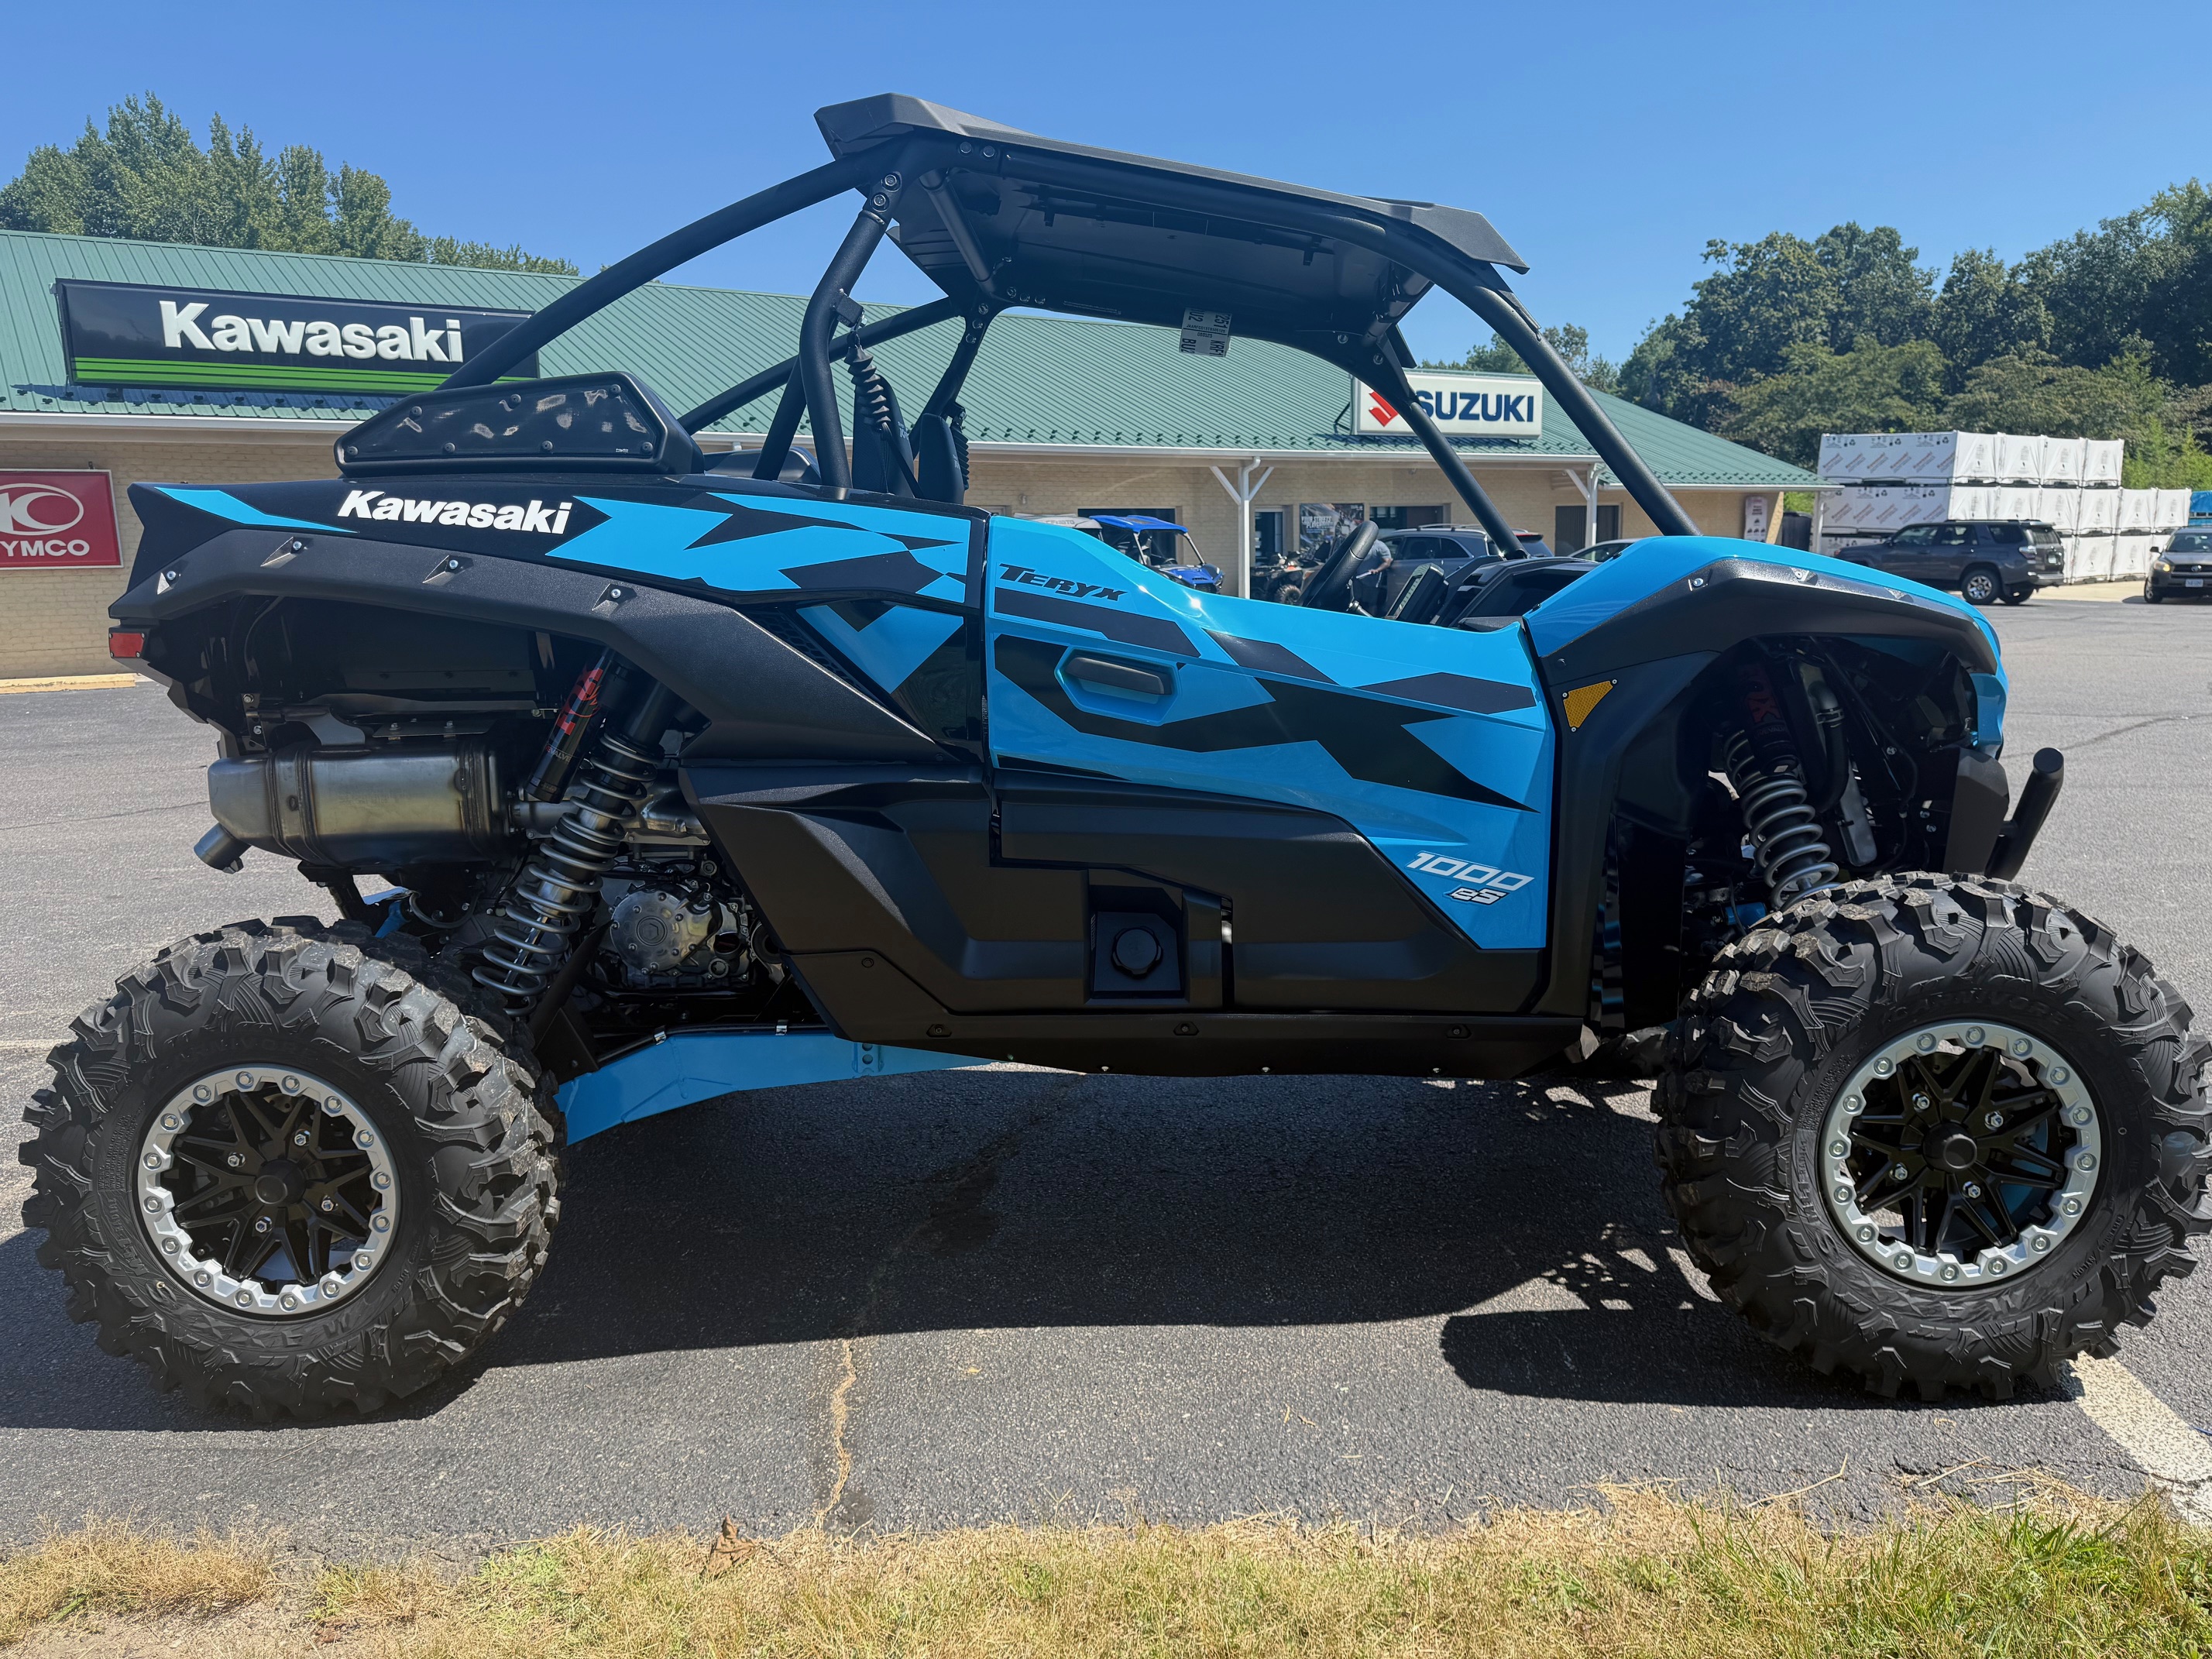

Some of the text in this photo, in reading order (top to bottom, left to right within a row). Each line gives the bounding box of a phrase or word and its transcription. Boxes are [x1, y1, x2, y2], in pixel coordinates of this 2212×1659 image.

[159, 300, 465, 363] Kawasaki
[1416, 390, 1534, 423] SUZUKI
[337, 489, 574, 535] Kawasaki
[0, 539, 90, 557] YMCO
[1406, 852, 1535, 891] 1000
